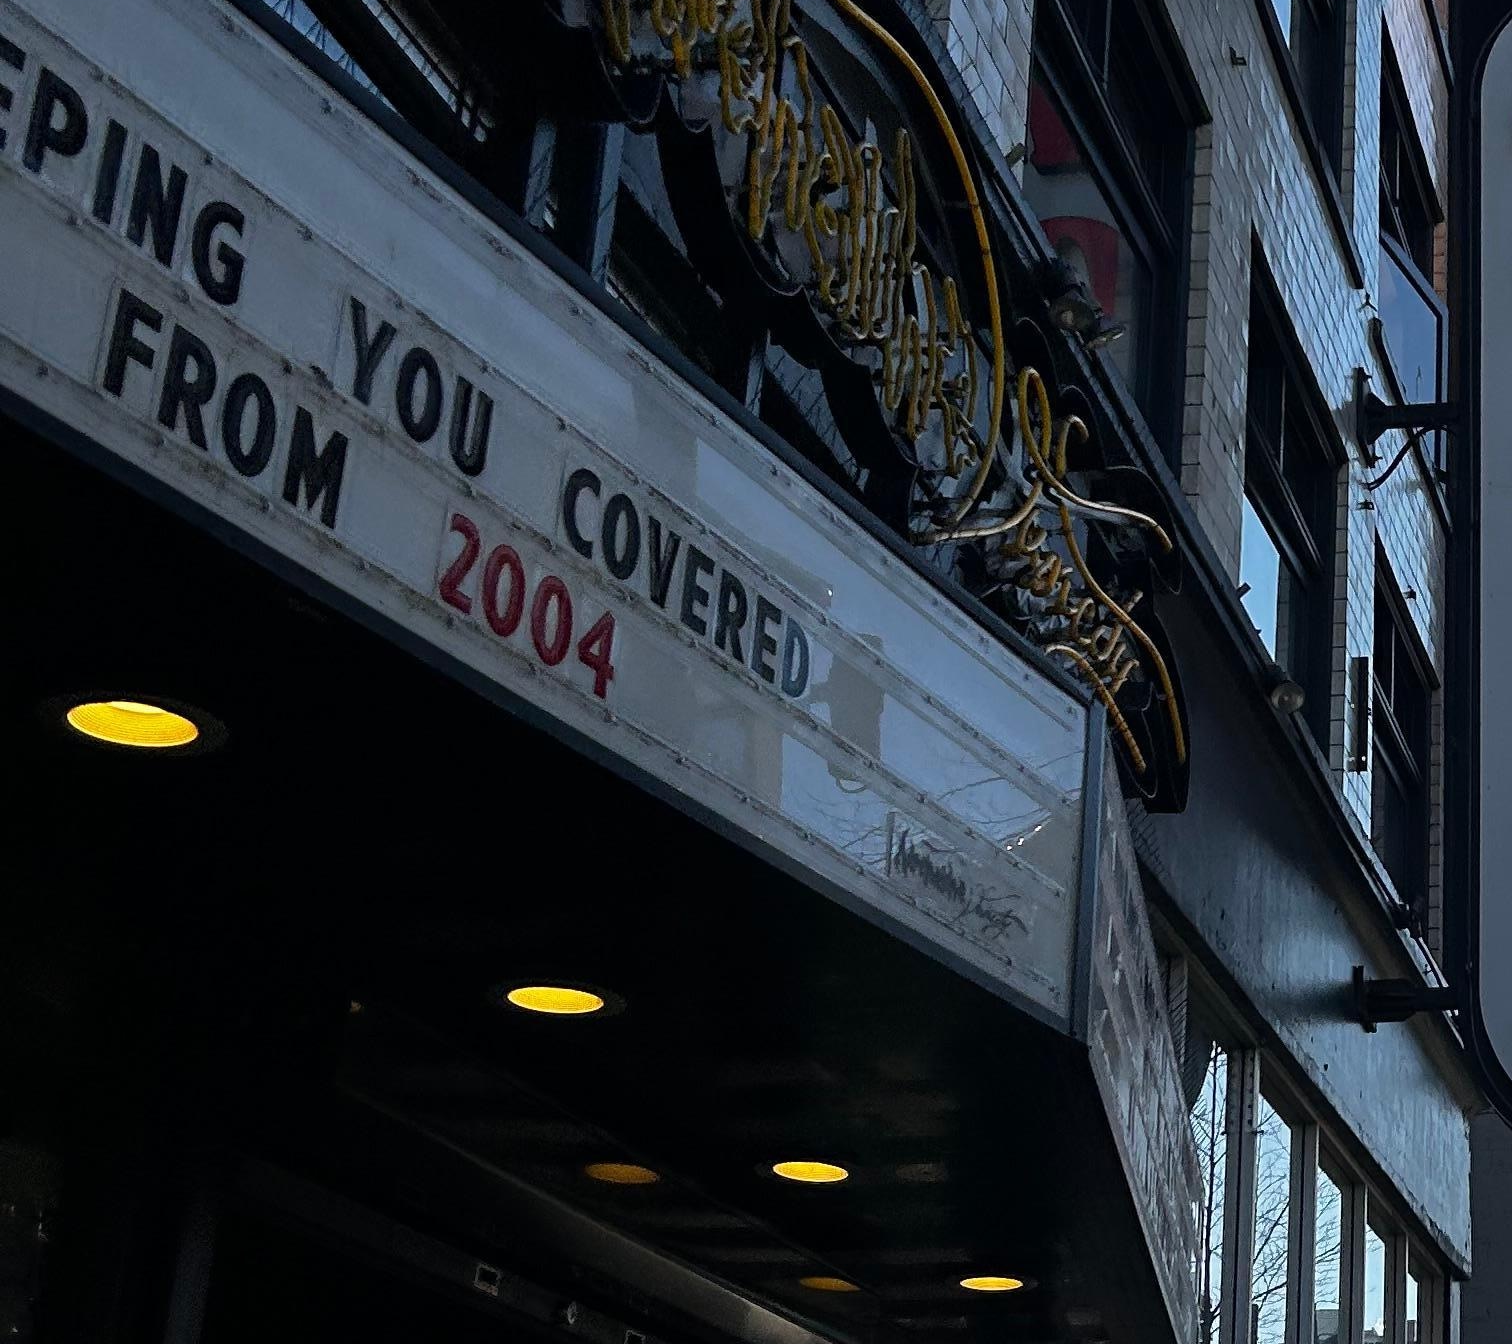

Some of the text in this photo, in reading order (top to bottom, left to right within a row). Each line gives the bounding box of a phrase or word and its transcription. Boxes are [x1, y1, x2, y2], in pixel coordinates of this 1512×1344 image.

[102, 289, 617, 699] FROM 2004
[350, 297, 494, 477] YOU
[564, 468, 812, 699] COVERED
